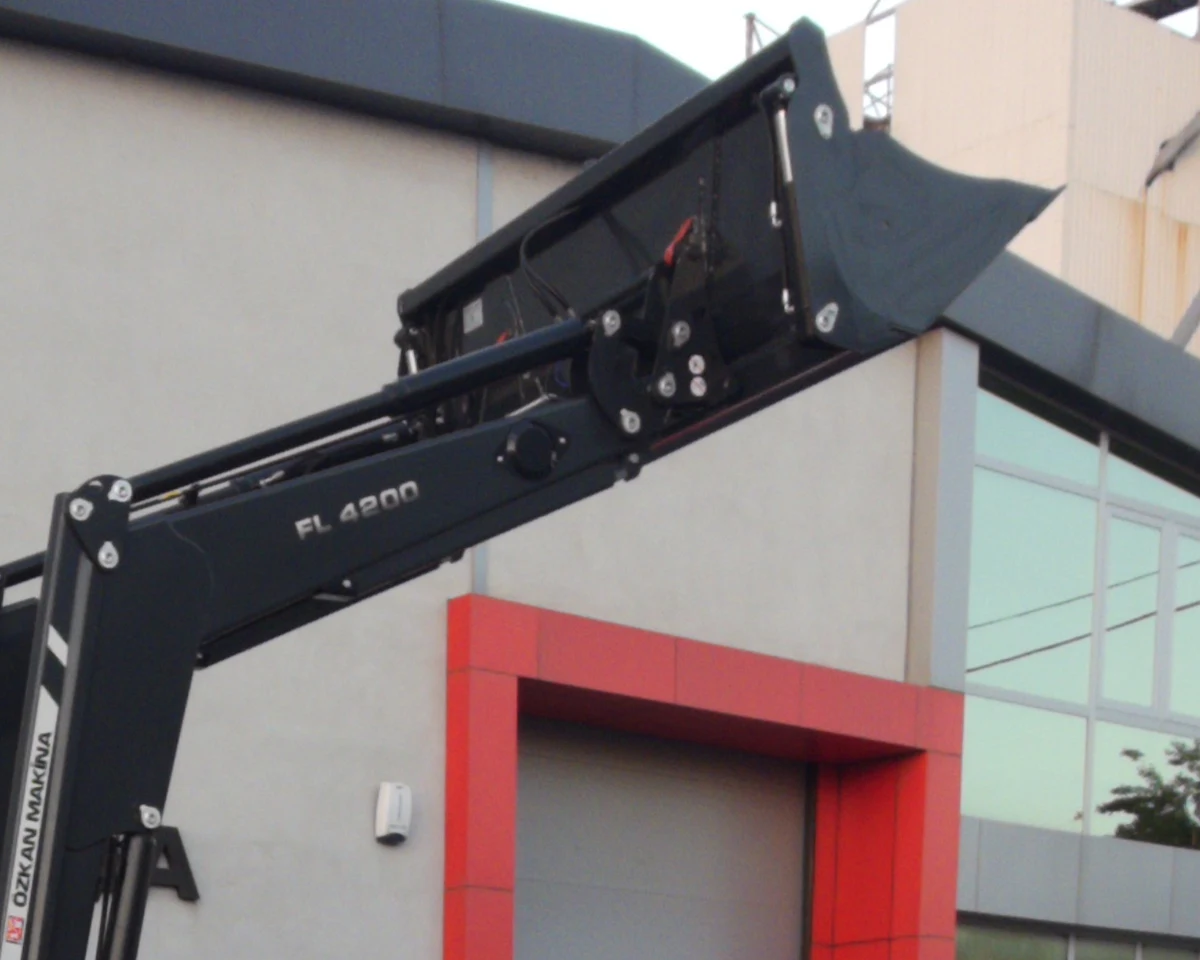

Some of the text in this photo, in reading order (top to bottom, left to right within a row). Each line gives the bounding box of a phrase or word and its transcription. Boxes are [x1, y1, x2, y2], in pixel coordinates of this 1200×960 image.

[294, 480, 419, 541] FL 4200
[12, 828, 38, 908] ÖZKAN
